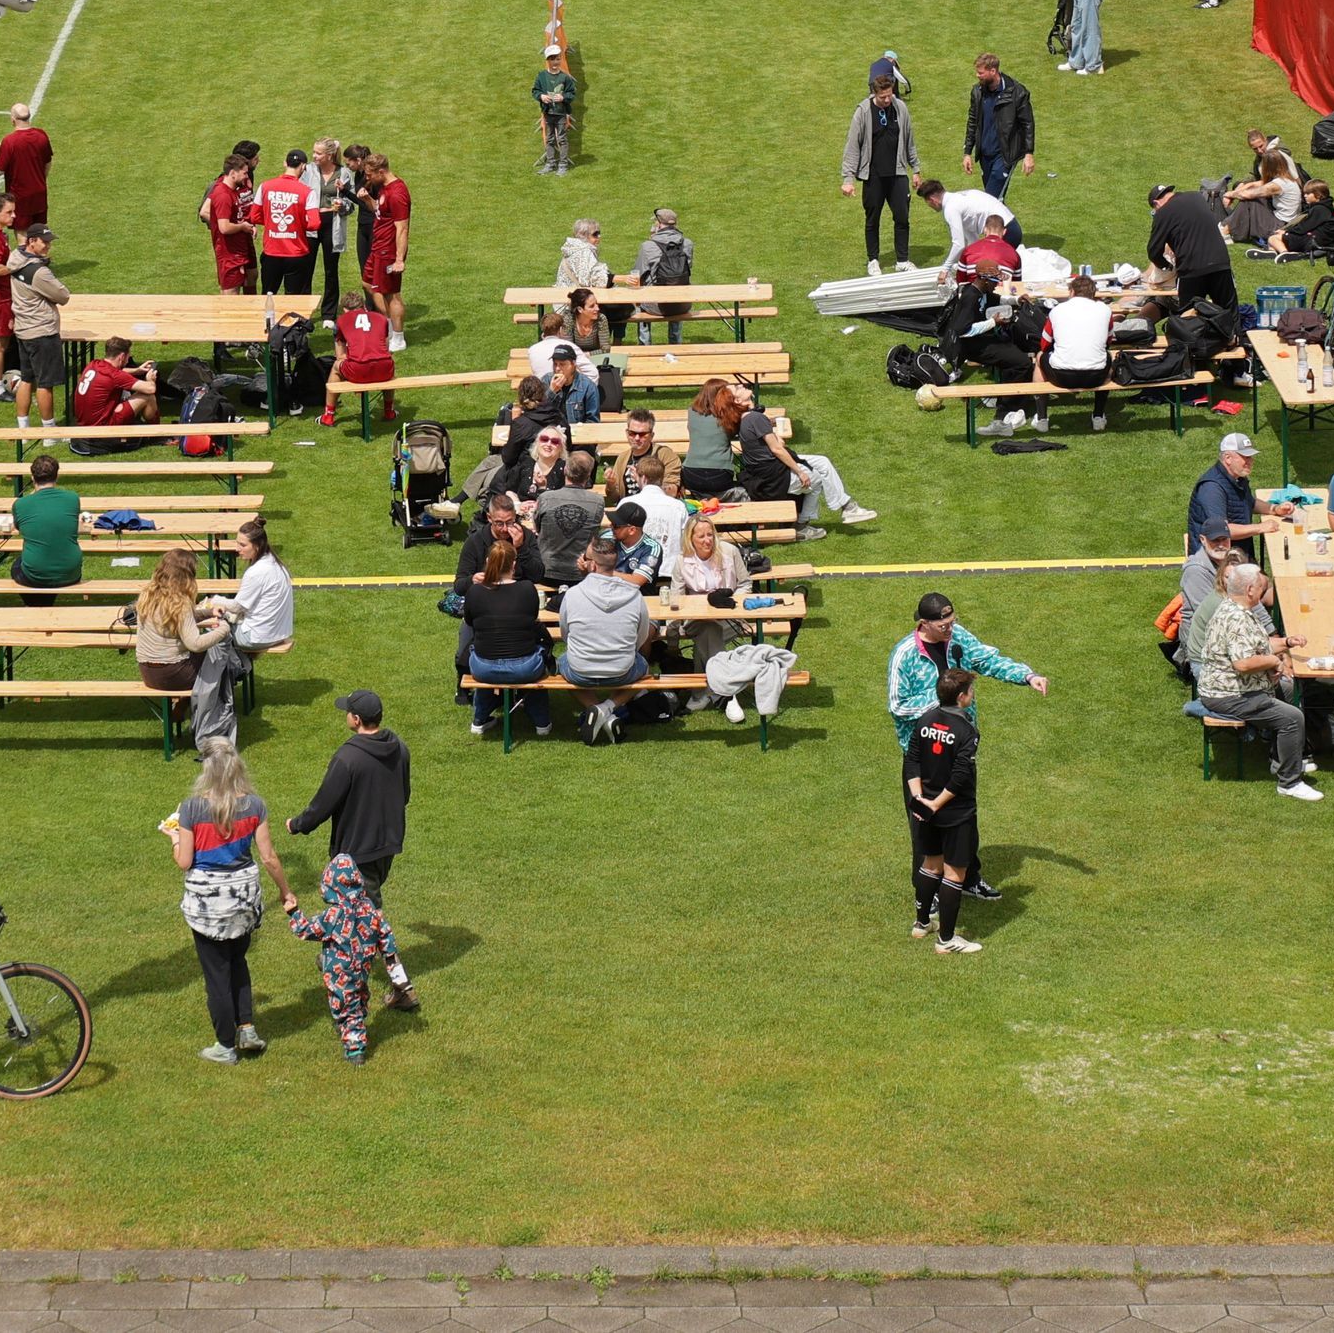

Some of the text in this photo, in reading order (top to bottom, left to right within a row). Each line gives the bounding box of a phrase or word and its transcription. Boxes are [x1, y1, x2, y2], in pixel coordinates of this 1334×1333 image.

[267, 190, 300, 204] REWE
[271, 202, 288, 212] SAP
[268, 229, 298, 239] hummel
[354, 313, 372, 332] 4
[77, 369, 97, 396] 3
[920, 725, 956, 746] ORTEC
